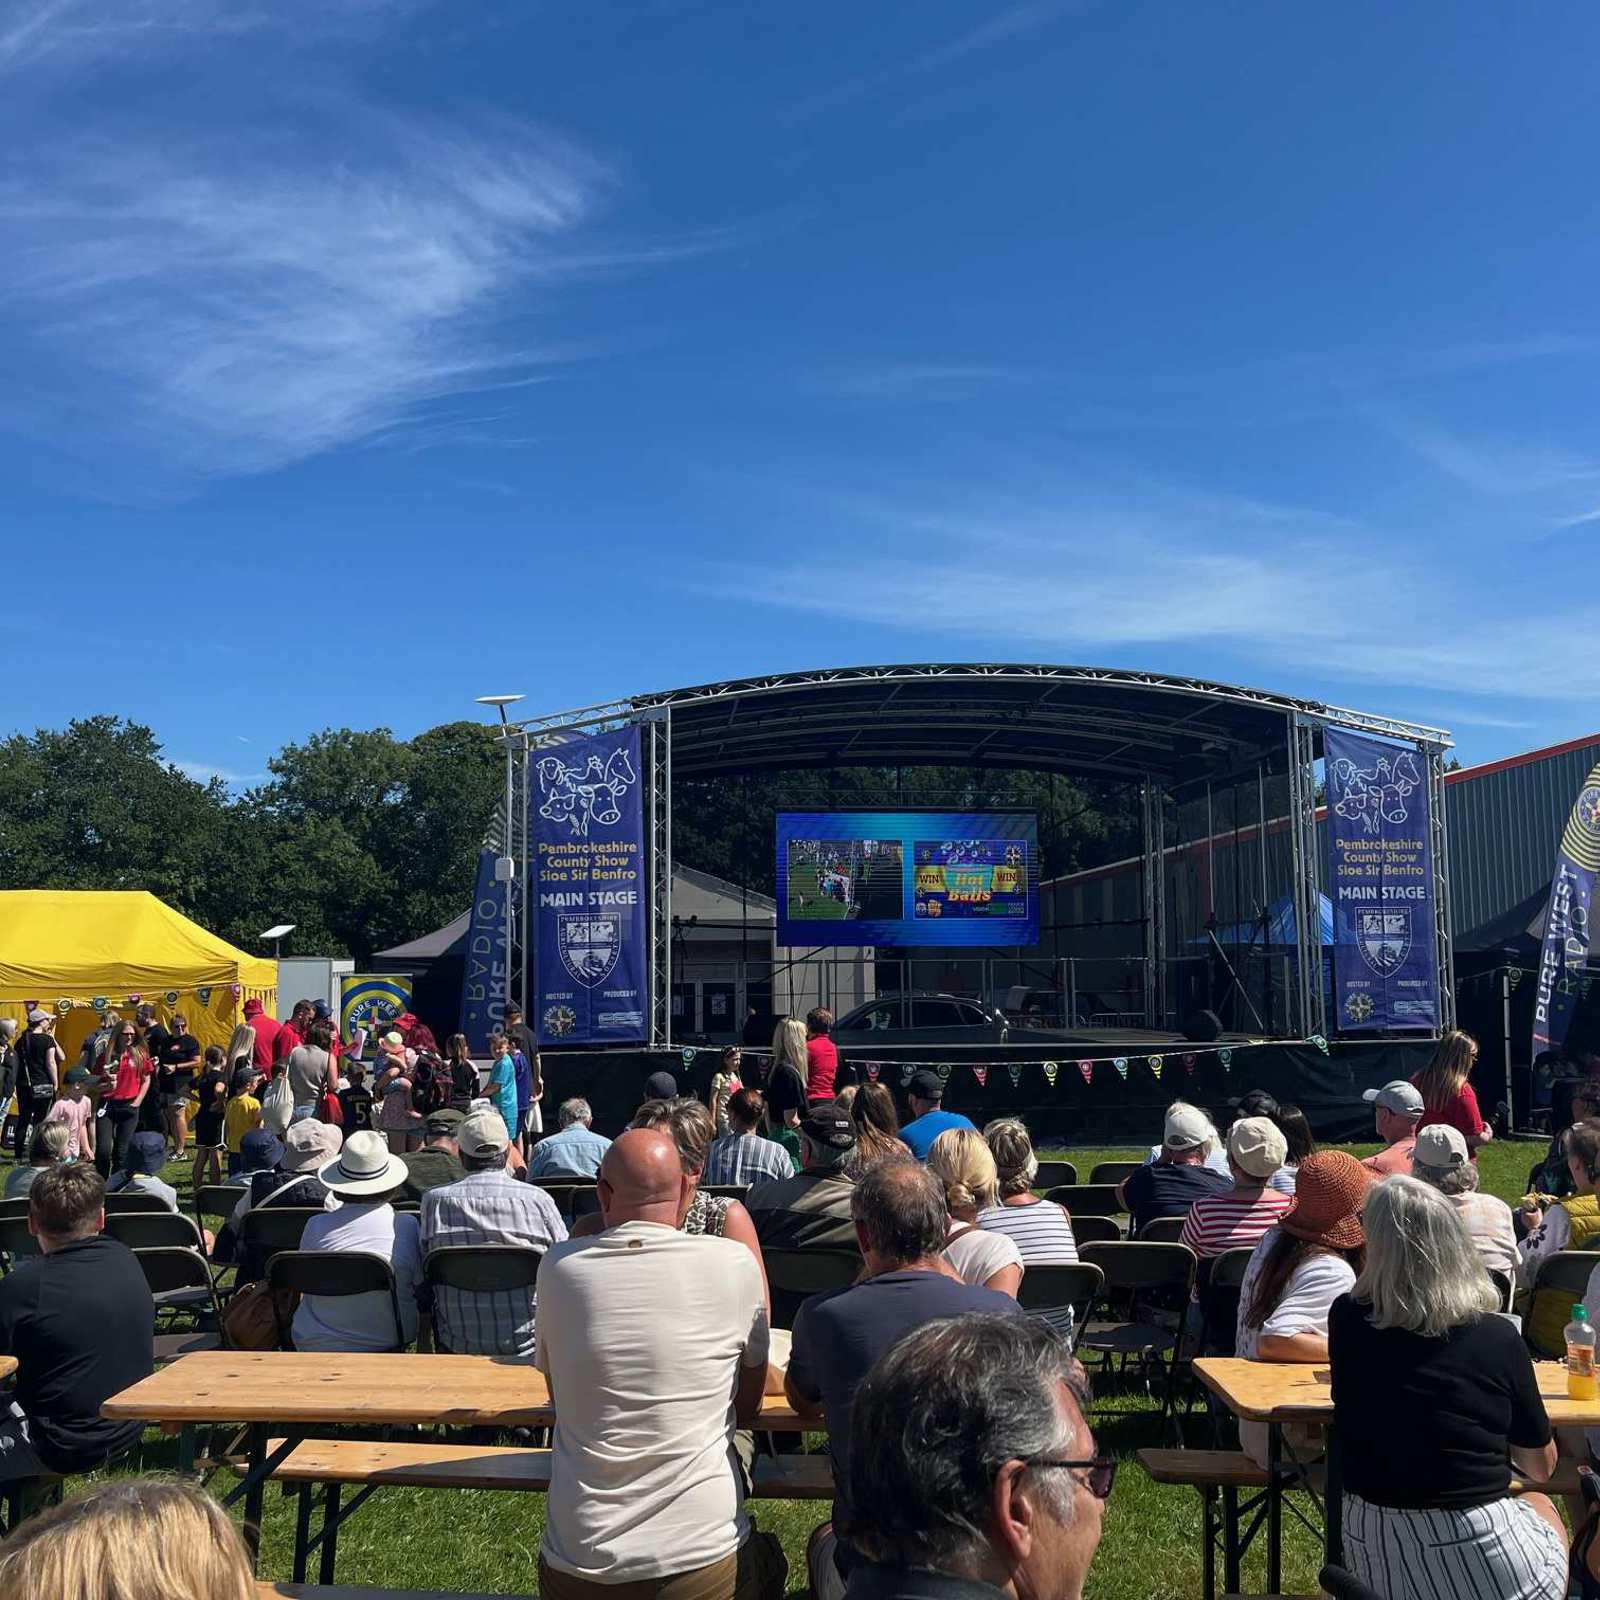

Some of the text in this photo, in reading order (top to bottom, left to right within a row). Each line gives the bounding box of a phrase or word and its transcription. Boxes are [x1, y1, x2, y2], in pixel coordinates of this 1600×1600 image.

[539, 841, 637, 854] Pembrokeshire
[1335, 839, 1424, 850] Pembrokeshire
[547, 854, 629, 868] County Show
[1343, 851, 1417, 863] County Show
[540, 867, 637, 881] Sioe Sir Benfro
[996, 871, 1017, 881] WIN
[1337, 864, 1424, 875] Sioe Sir Benfro
[919, 874, 940, 884] WIN
[540, 890, 638, 907] MAIN STAGE
[1338, 886, 1426, 900] MAIN STAGE
[1535, 863, 1578, 1023] PURE WEST
[1556, 906, 1590, 996] RADIO
[350, 1000, 397, 1022] PURE WES
[355, 1102, 366, 1123] 5
